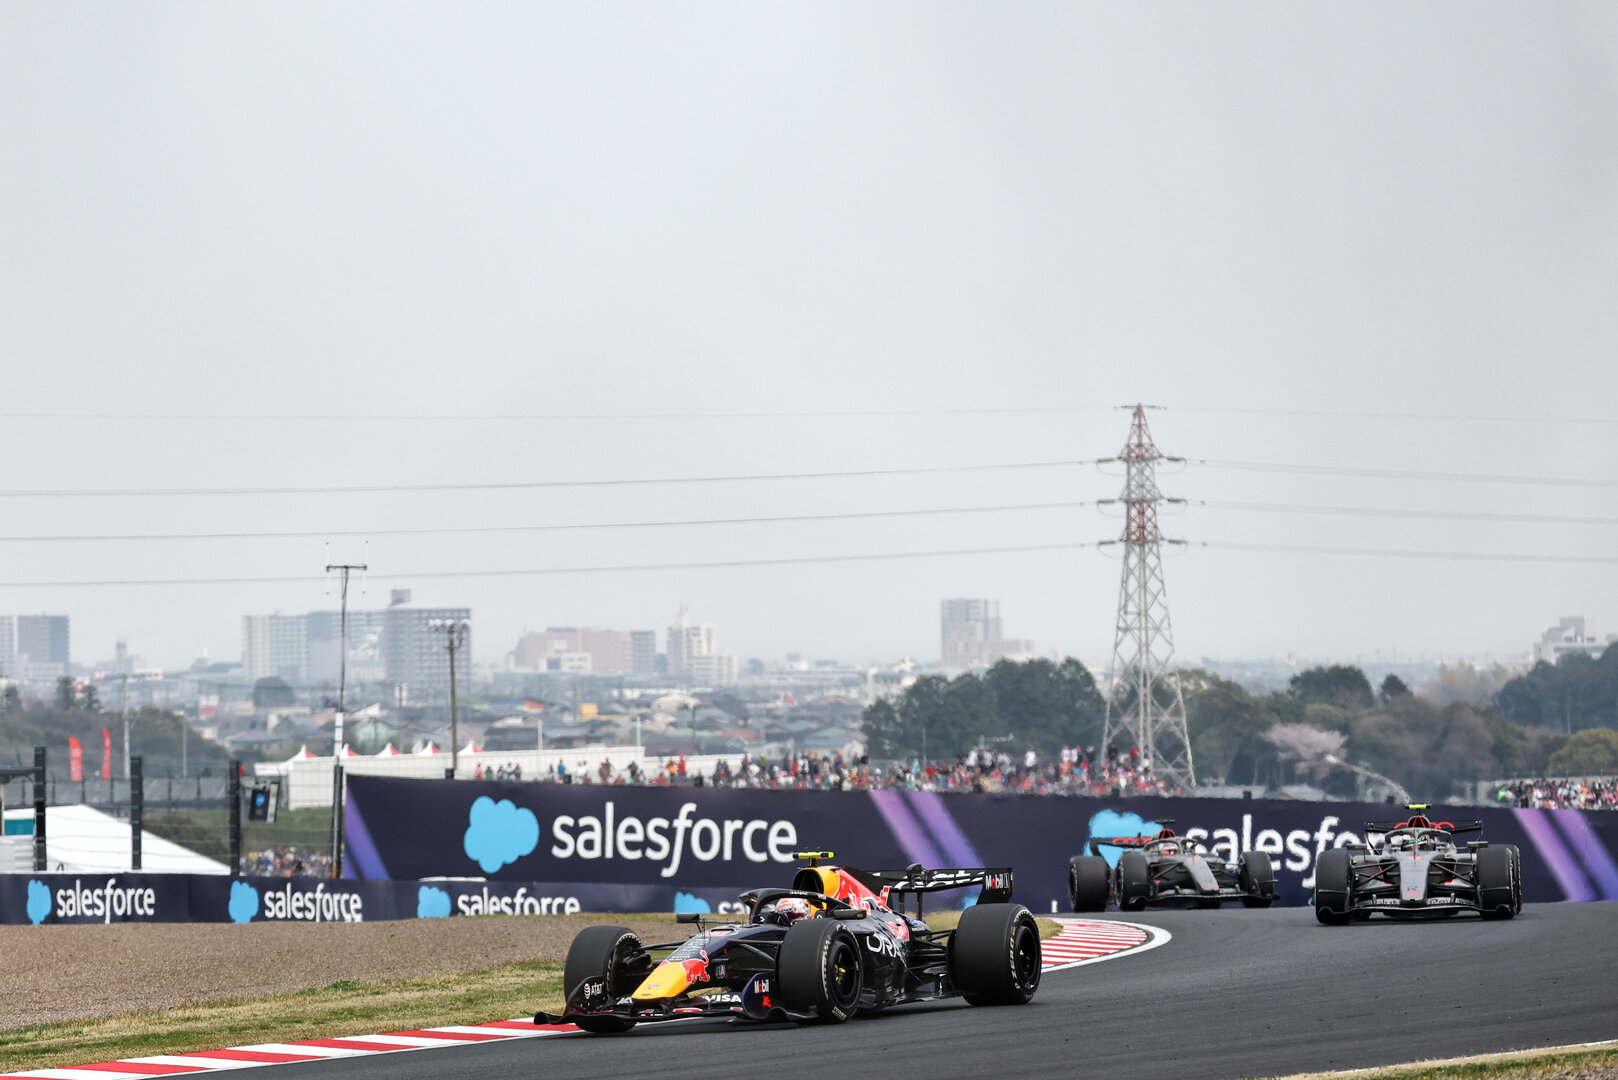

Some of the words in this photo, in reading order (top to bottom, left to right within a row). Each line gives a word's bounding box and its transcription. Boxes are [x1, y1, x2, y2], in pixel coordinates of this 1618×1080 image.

[551, 801, 798, 878] salesforce
[985, 874, 1004, 891] Mobil
[56, 878, 155, 924] salesforce
[264, 882, 363, 922] salesforce
[457, 886, 581, 916] salesforce
[703, 994, 742, 1003] VISA
